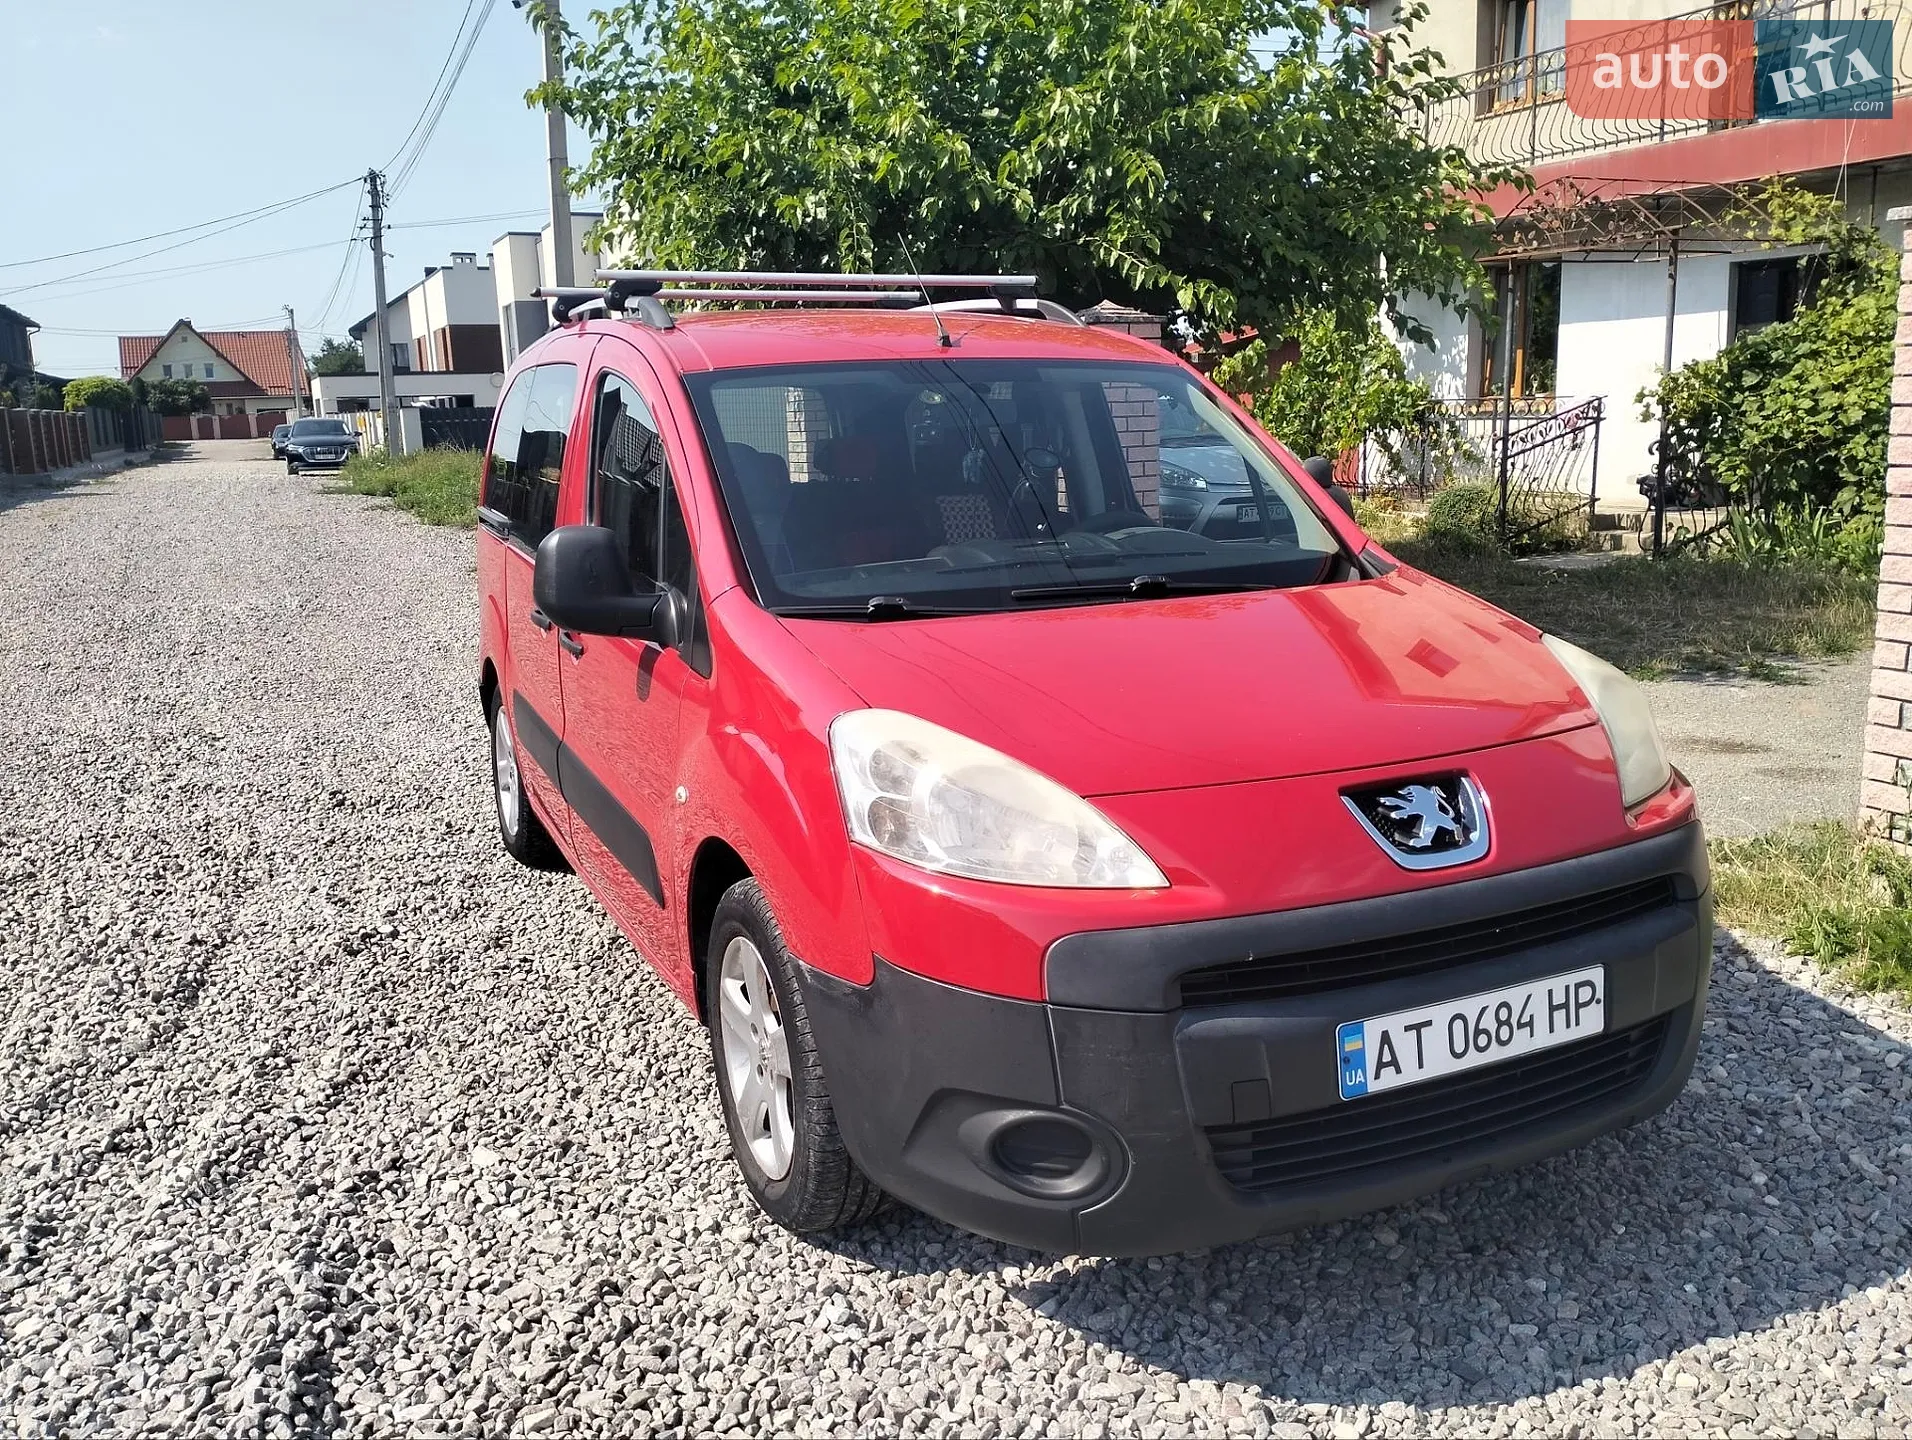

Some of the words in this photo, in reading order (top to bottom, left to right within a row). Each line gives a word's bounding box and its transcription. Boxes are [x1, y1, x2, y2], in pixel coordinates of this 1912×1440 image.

[1373, 1019, 1433, 1080] AT
[1447, 993, 1535, 1060] 0684
[1547, 979, 1598, 1034] HP
[1346, 1068, 1366, 1085] UA
